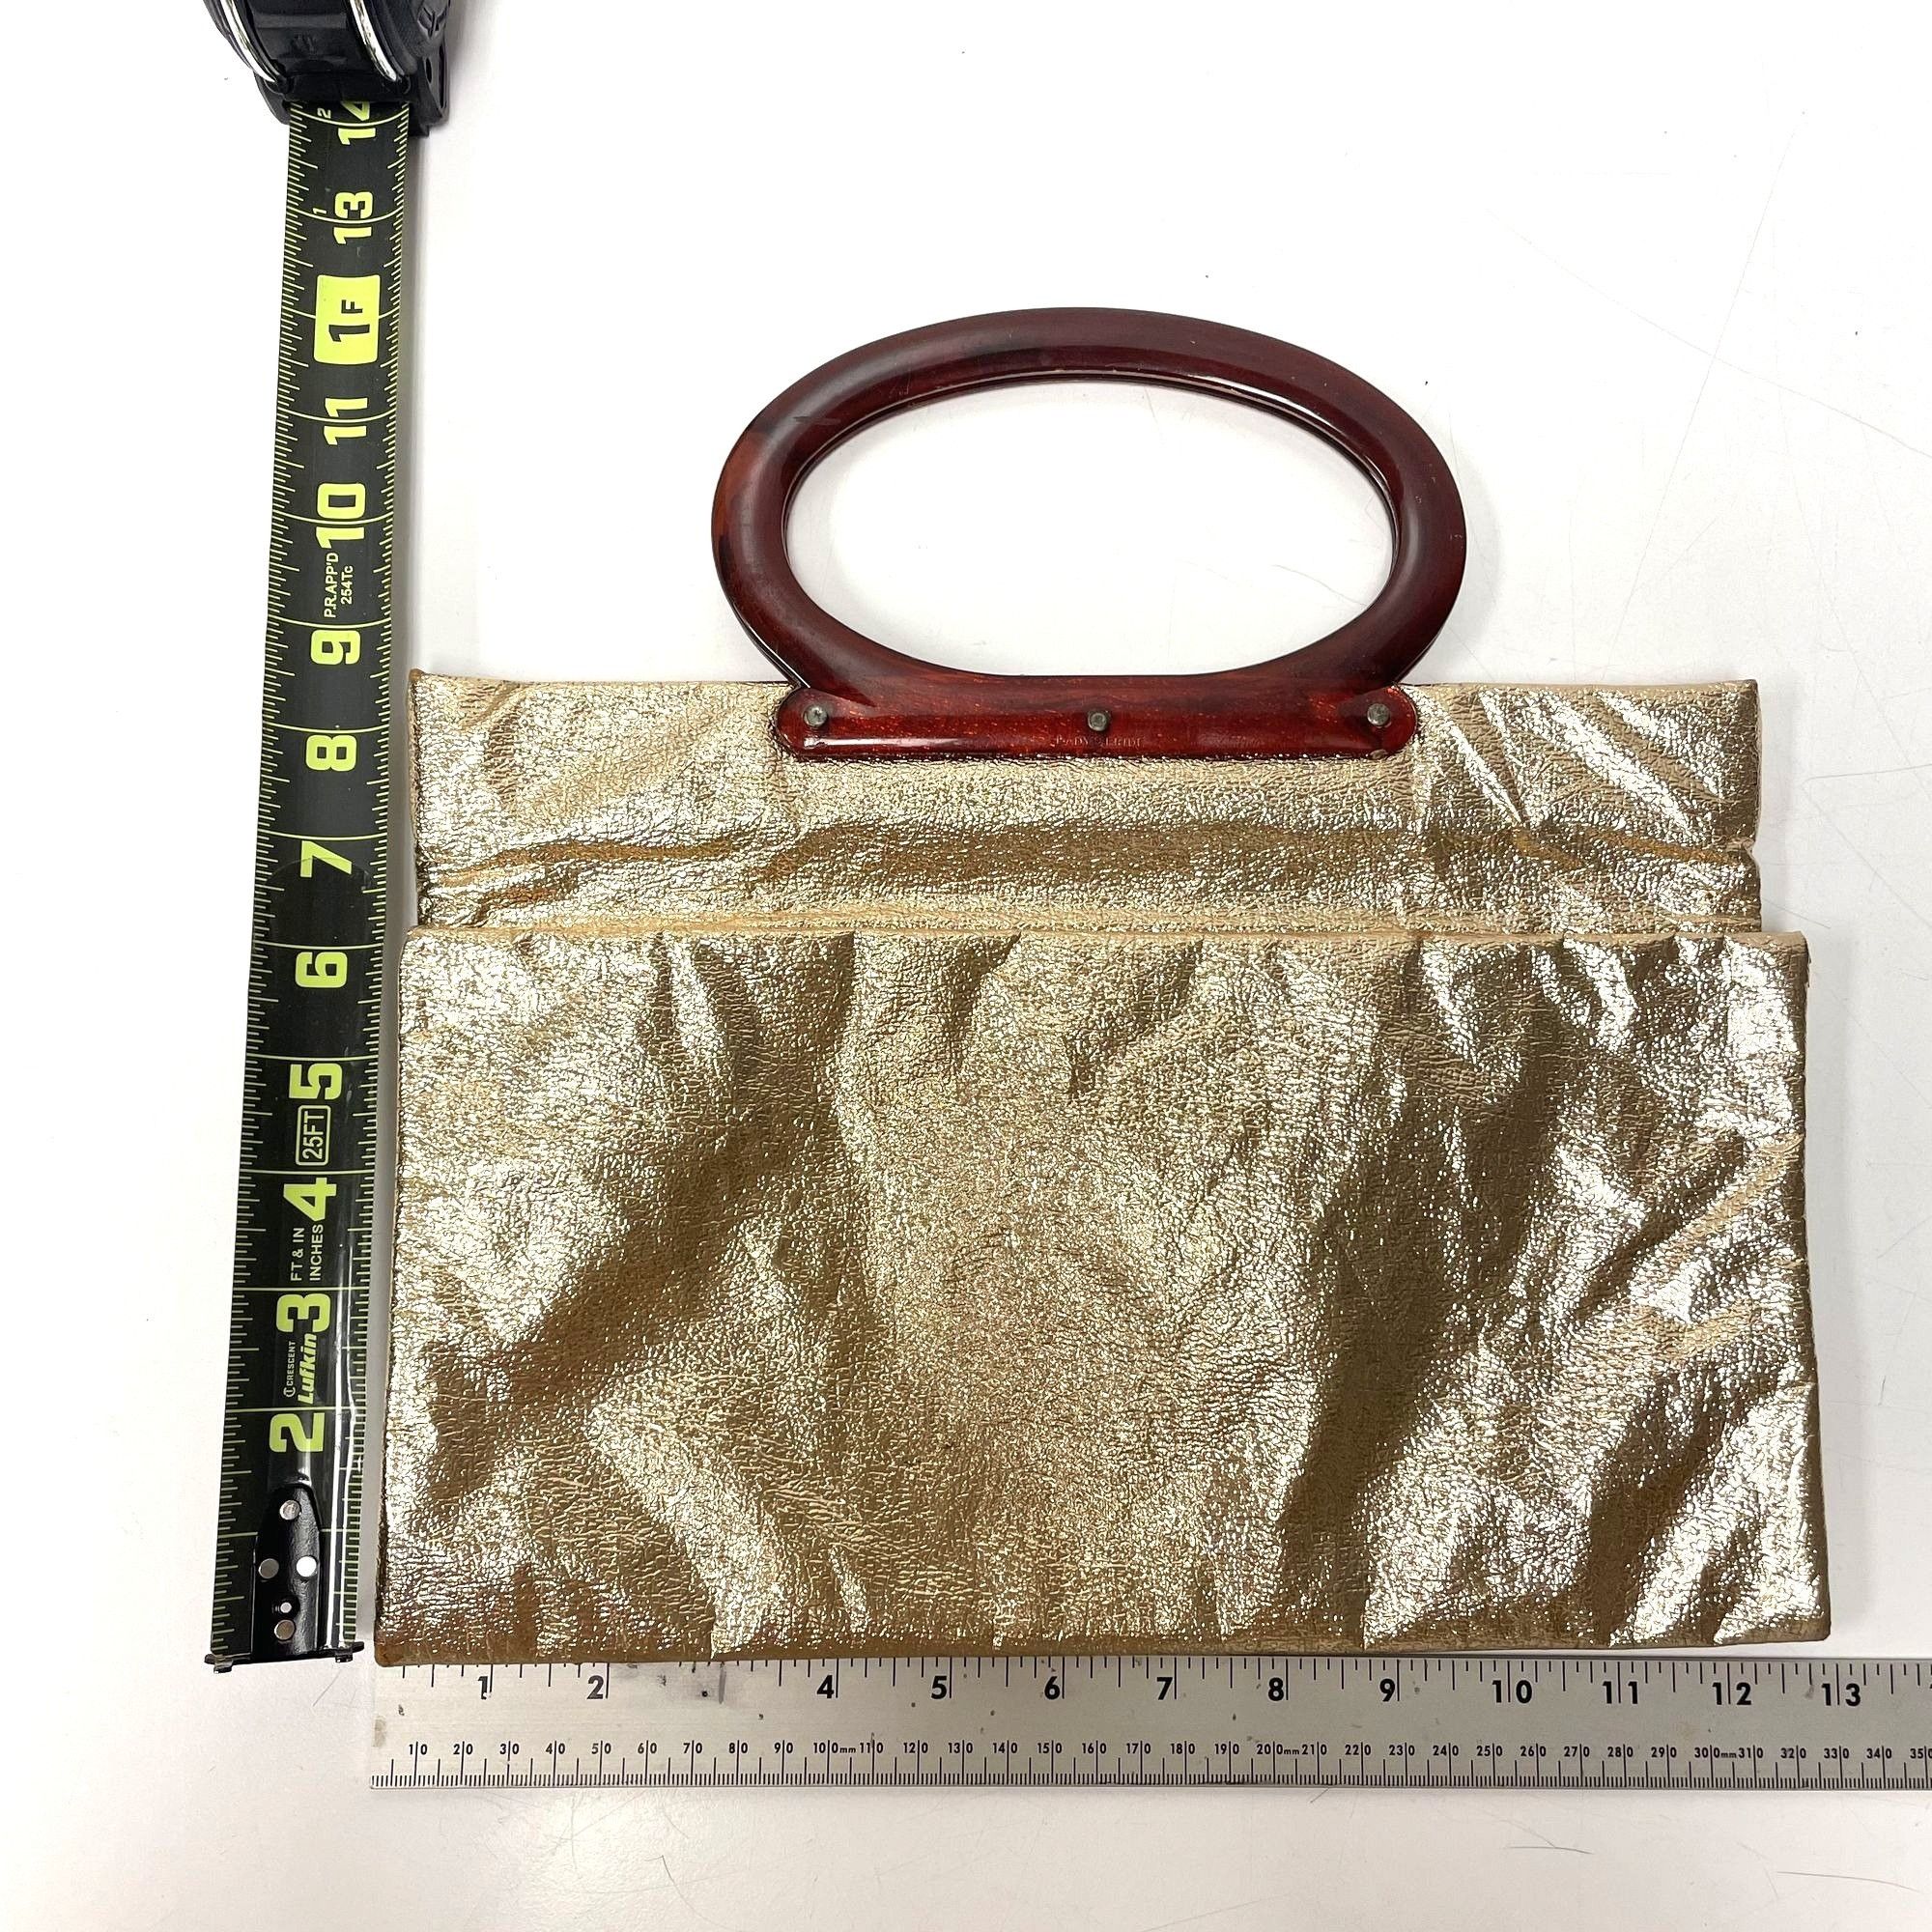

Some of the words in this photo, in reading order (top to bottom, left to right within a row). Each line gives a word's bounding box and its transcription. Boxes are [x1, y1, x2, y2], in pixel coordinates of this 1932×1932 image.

[333, 191, 374, 244] 13
[324, 397, 368, 445] 11
[316, 483, 366, 549] 10
[310, 629, 361, 666] 9
[305, 734, 357, 771] 8
[299, 840, 352, 878] 7
[295, 951, 348, 988] 6
[288, 1063, 343, 1100] 5
[301, 1111, 325, 1159] 25FT
[283, 1177, 337, 1222] 4
[293, 1228, 305, 1243] IN
[292, 1249, 304, 1258] &
[309, 1224, 324, 1281] INCHES
[290, 1262, 303, 1281] FT
[275, 1293, 331, 1333] 3
[286, 1341, 296, 1386] CRESCENT
[298, 1333, 317, 1405] Lufkin
[269, 1412, 326, 1453] 2
[478, 1675, 489, 1700] 1
[586, 1674, 605, 1700] 2
[816, 1674, 835, 1699] 4
[930, 1675, 948, 1700] 5
[1044, 1675, 1061, 1700] 6
[1156, 1677, 1174, 1700] 7
[1267, 1677, 1285, 1701] 8
[1379, 1678, 1396, 1702] 9
[1492, 1680, 1533, 1703] 10
[1602, 1681, 1638, 1704] 11
[1712, 1682, 1752, 1706] 12
[1821, 1683, 1861, 1707] 13
[408, 1744, 428, 1755] 10
[453, 1744, 473, 1755] 20
[499, 1743, 520, 1754] 30
[545, 1743, 566, 1754] 40
[591, 1743, 611, 1754] 50
[637, 1743, 658, 1754] 60
[683, 1743, 703, 1754] 70
[728, 1743, 749, 1754] 80
[774, 1743, 794, 1754] 90
[860, 1743, 884, 1754] 110
[903, 1742, 928, 1753] 120
[948, 1742, 973, 1753] 130
[992, 1742, 1018, 1753] 140
[1037, 1742, 1063, 1753] 150
[1082, 1742, 1107, 1753] 160
[1126, 1743, 1151, 1754] 170
[1170, 1744, 1196, 1755] 180
[1214, 1744, 1239, 1755] 190
[1301, 1744, 1327, 1755] 210
[1345, 1745, 1372, 1756] 220
[1388, 1745, 1415, 1756] 230
[1433, 1745, 1460, 1756] 240
[1476, 1746, 1503, 1757] 250
[1520, 1746, 1547, 1757] 260
[1563, 1746, 1590, 1757] 270
[1606, 1747, 1634, 1758] 280
[1650, 1747, 1677, 1758] 290
[1738, 1747, 1764, 1759] 310
[1780, 1747, 1806, 1759] 320
[1823, 1747, 1850, 1759] 330
[1865, 1747, 1892, 1759] 340
